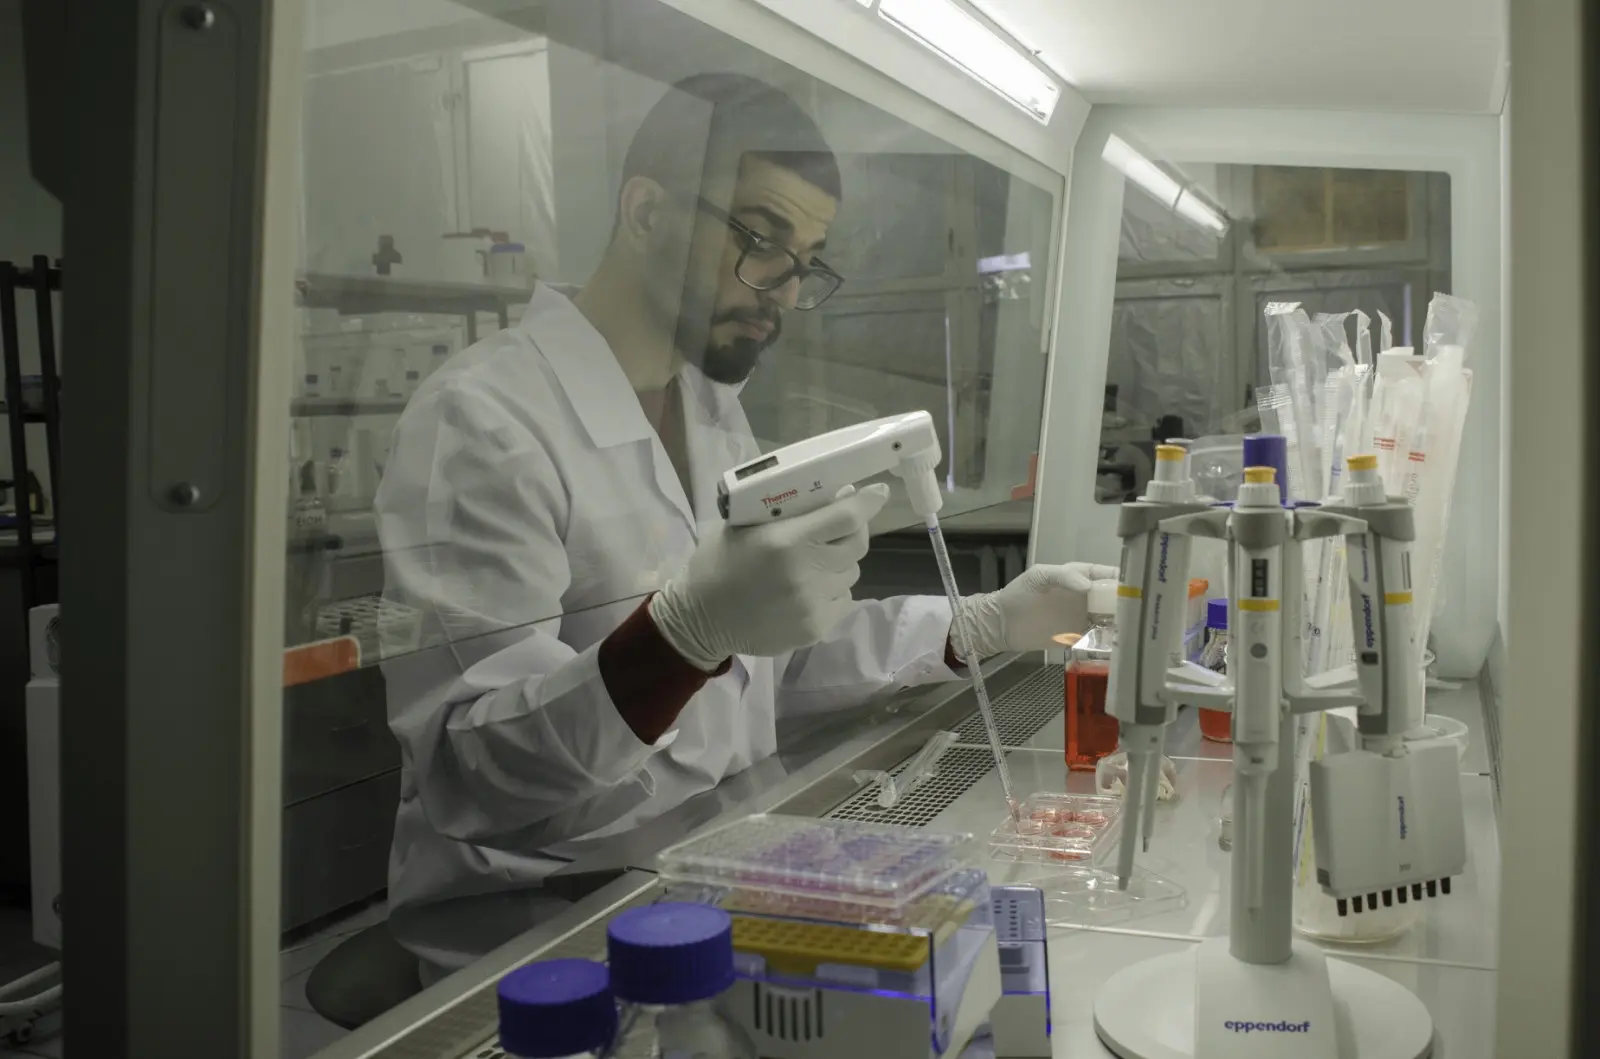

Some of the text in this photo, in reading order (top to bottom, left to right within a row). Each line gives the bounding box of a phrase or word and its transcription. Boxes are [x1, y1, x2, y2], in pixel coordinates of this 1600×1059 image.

[761, 489, 798, 507] Thermo
[1361, 594, 1375, 648] eppendorf
[1224, 1020, 1310, 1033] eppendorf
